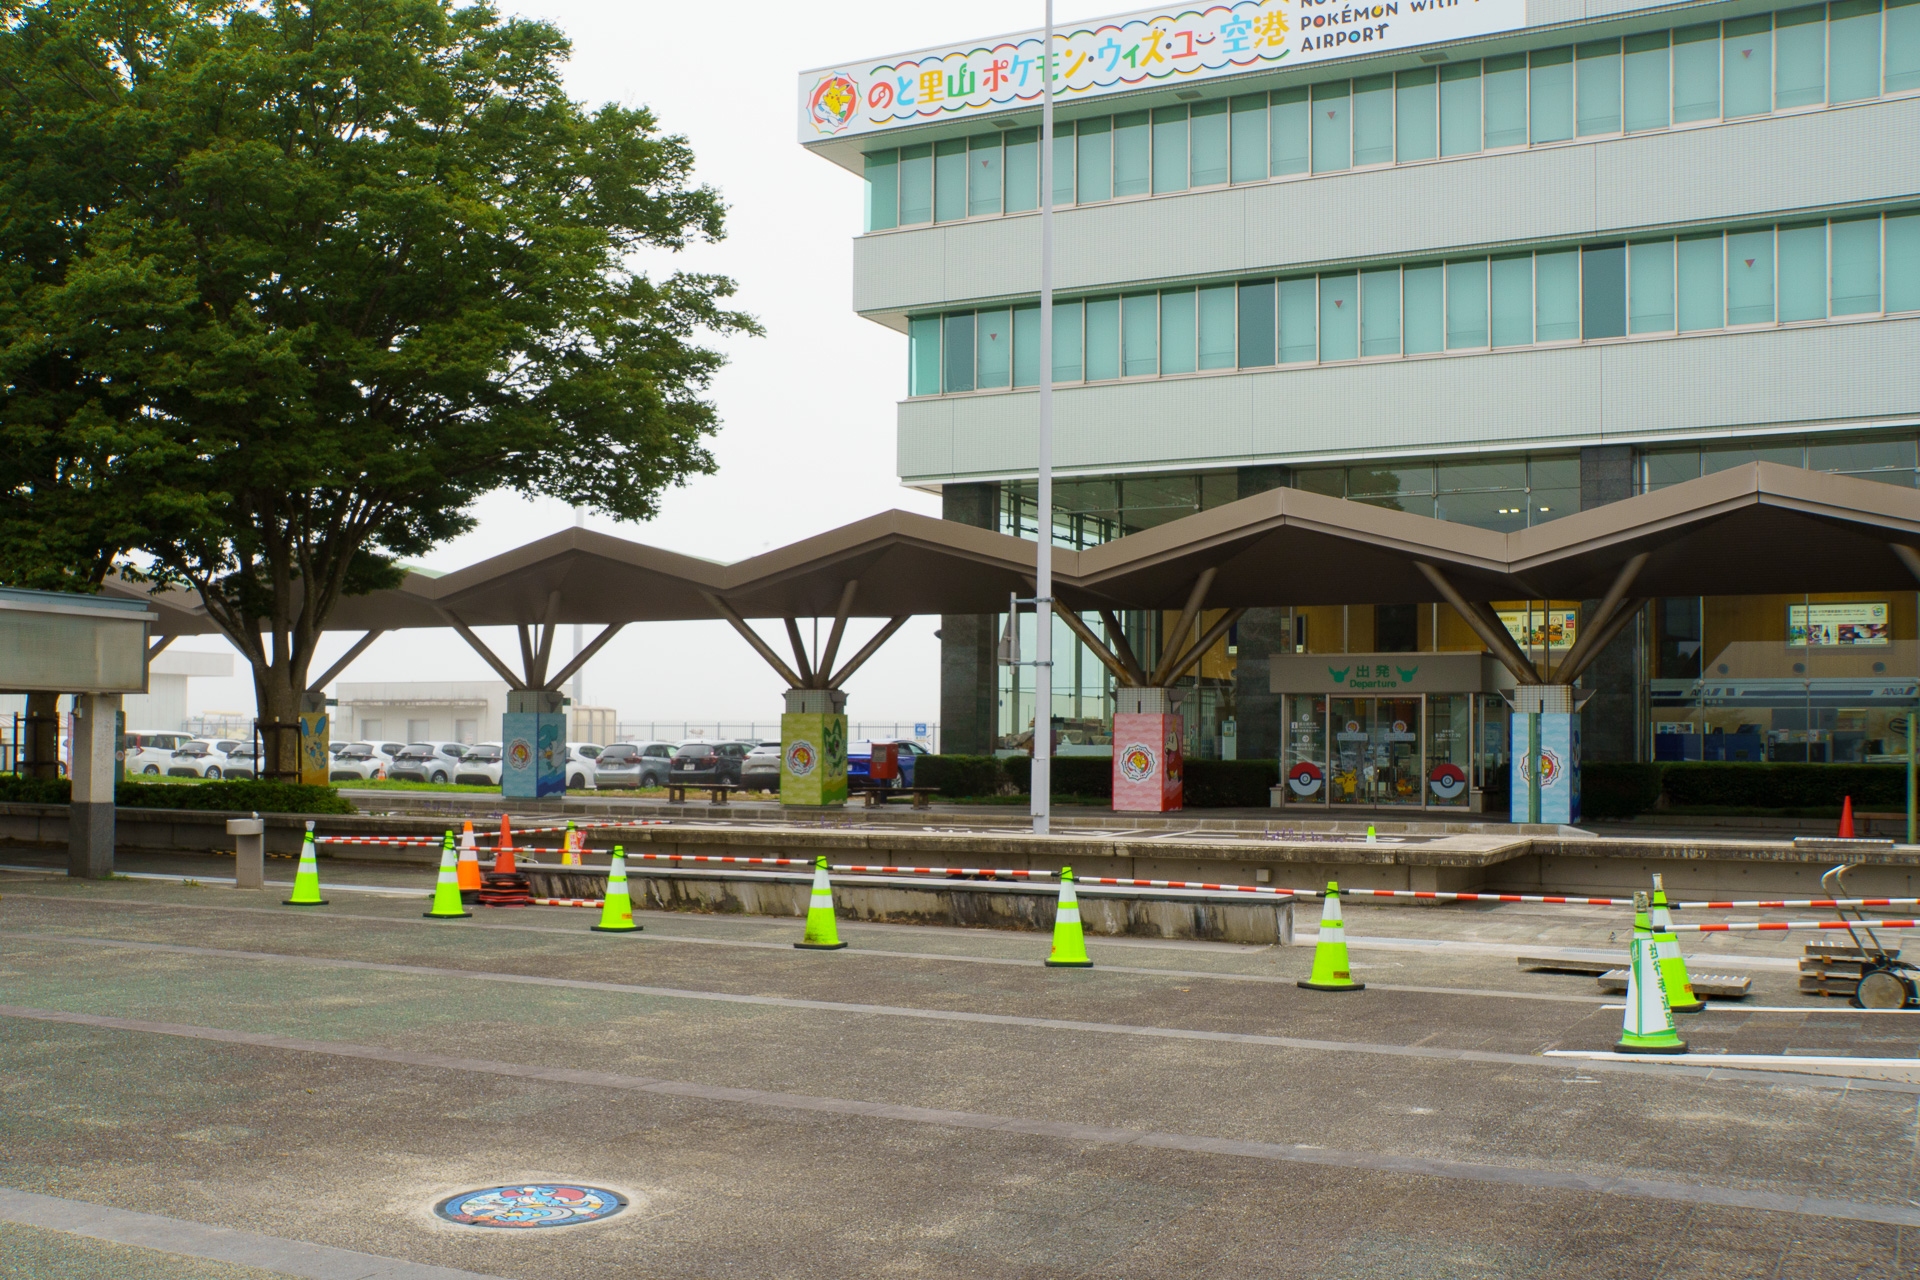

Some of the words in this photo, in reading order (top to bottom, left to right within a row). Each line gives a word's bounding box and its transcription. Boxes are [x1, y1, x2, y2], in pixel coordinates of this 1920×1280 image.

[1300, 2, 1398, 31] POKÉMON
[1300, 23, 1389, 52] AIRPORT
[1356, 664, 1390, 678] 出発
[1349, 679, 1397, 690] Departure
[1880, 687, 1905, 696] ANA
